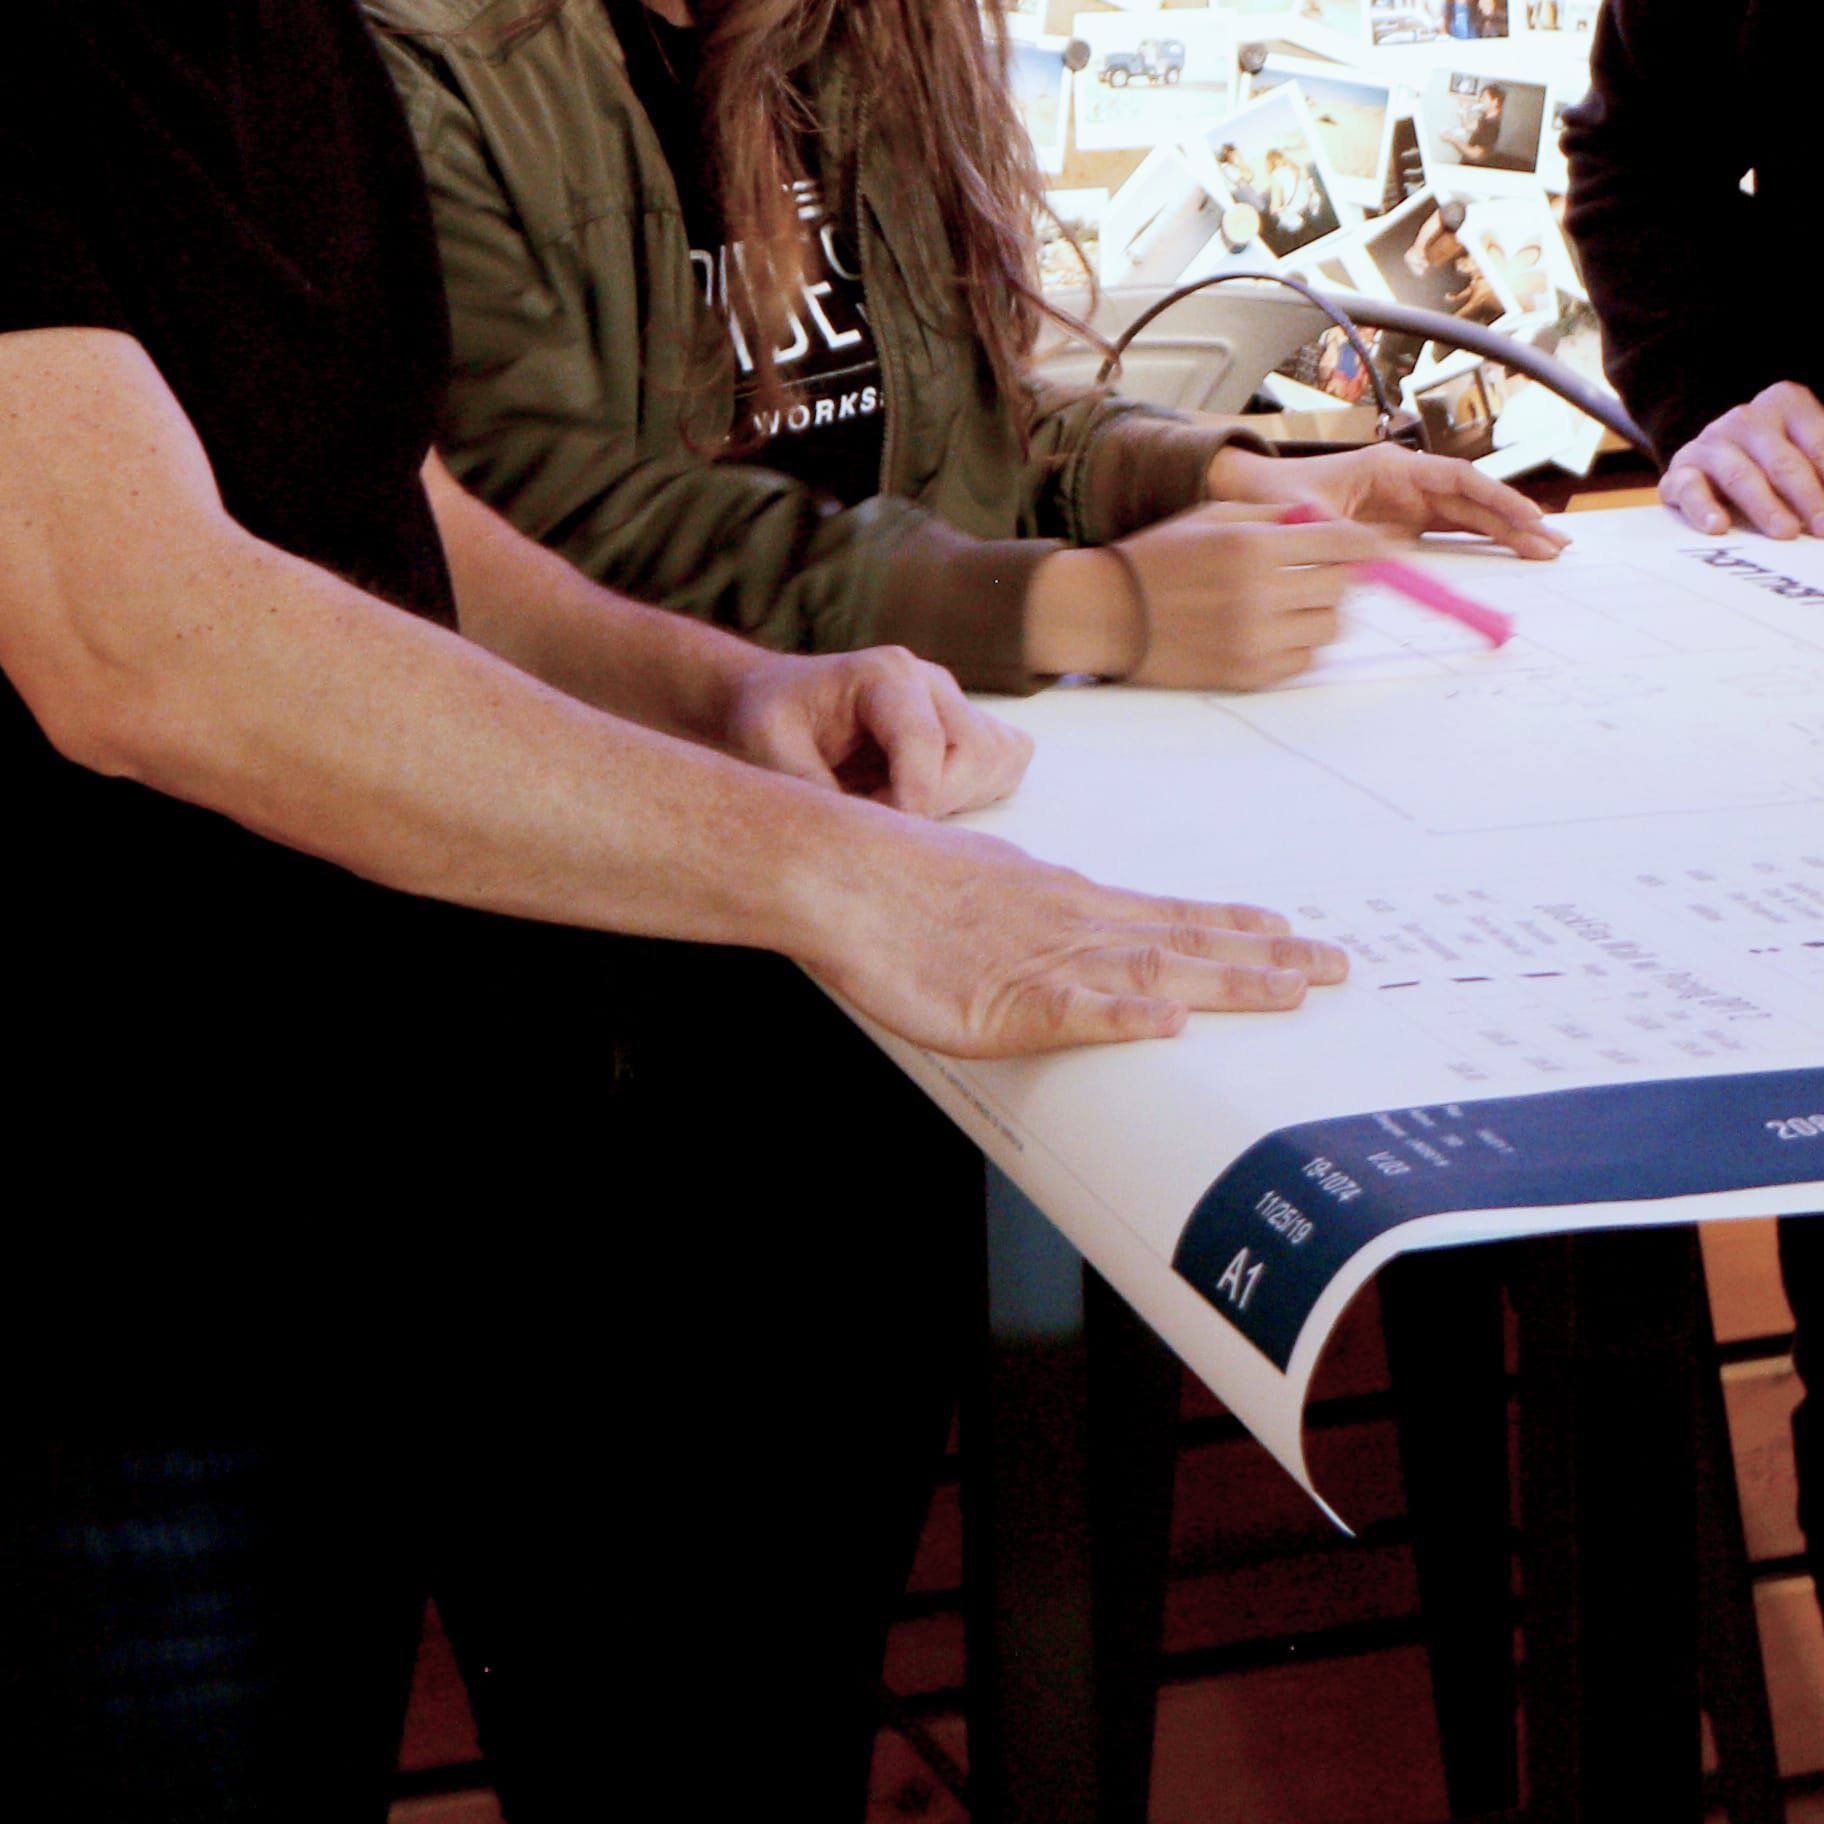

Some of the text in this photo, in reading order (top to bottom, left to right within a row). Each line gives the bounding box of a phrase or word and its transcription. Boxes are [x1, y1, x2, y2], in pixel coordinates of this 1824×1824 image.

[753, 385, 884, 437] WORKS
[1254, 1189, 1315, 1245] 11/25/19
[1215, 1245, 1266, 1311] A1
